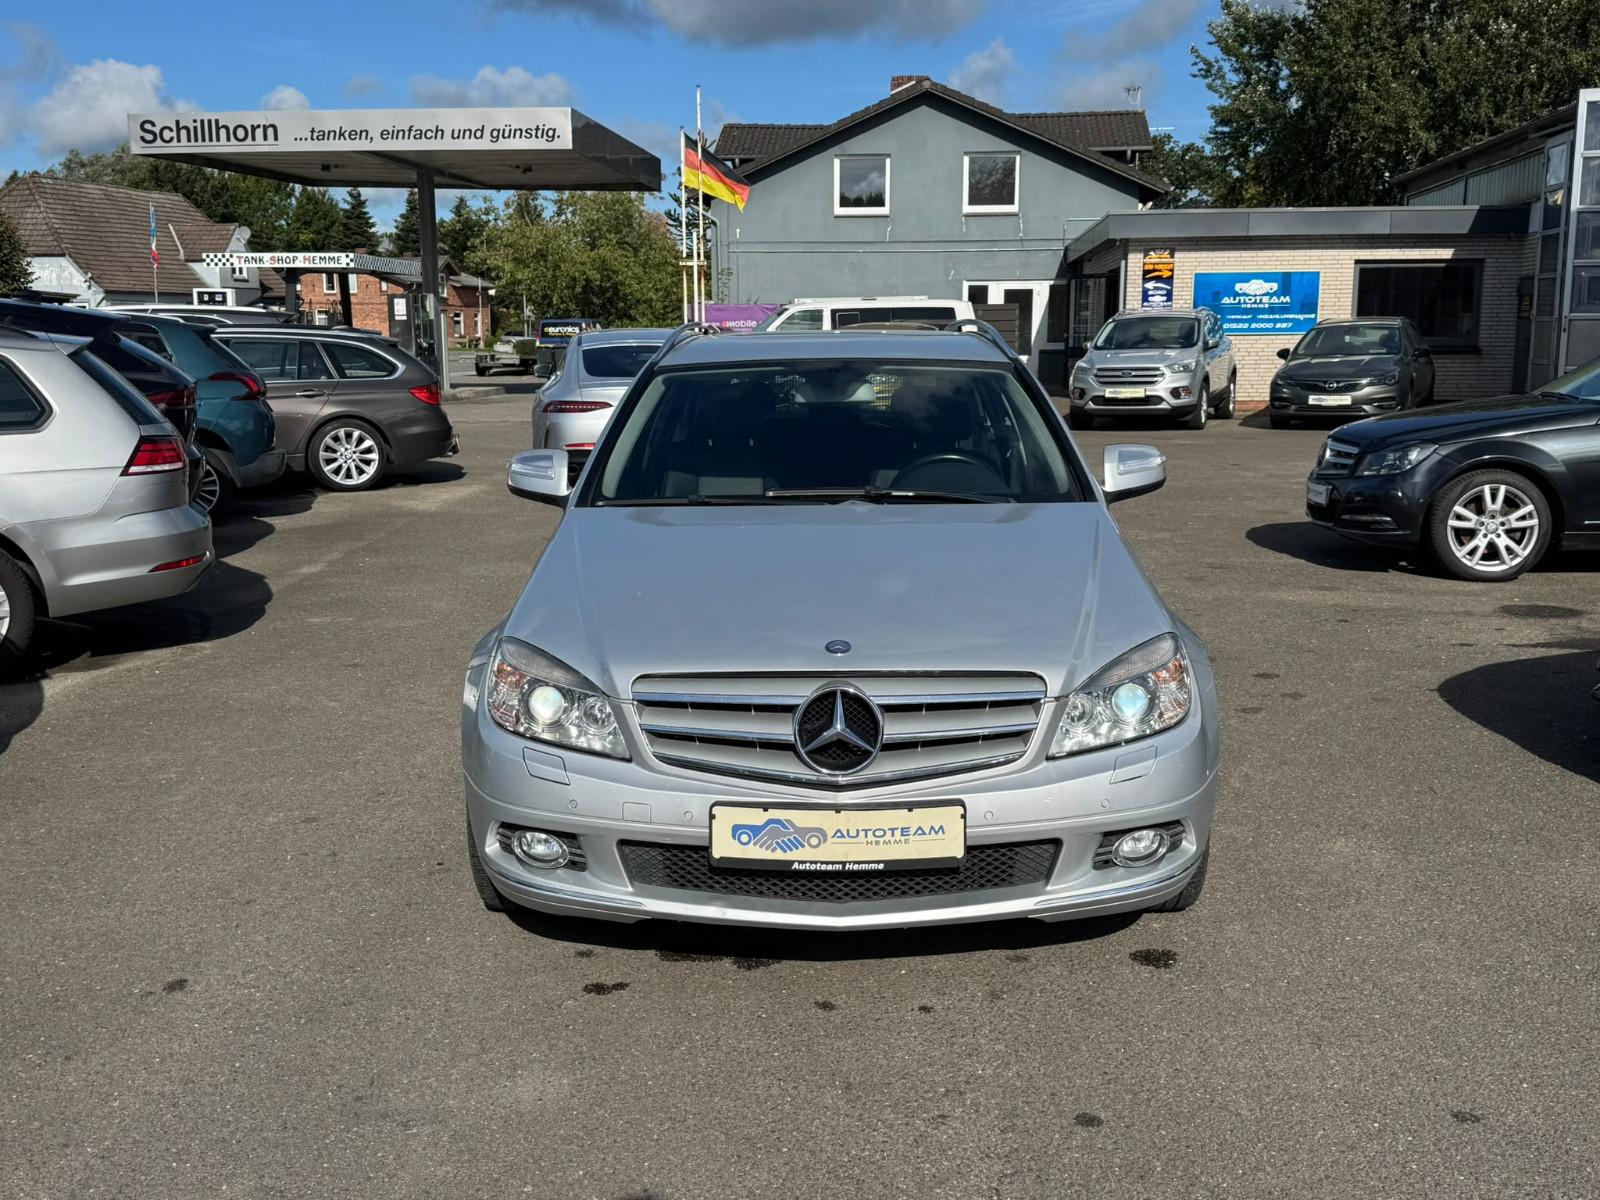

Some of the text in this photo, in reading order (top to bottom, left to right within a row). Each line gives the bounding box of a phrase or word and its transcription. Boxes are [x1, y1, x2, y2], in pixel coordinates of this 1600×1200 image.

[139, 118, 279, 144] Schillhorn
[293, 123, 561, 143] ...tanken, einfach und günstig.
[1220, 295, 1291, 304] AUTOTEAM
[831, 824, 946, 839] AUTOTEAM
[865, 838, 911, 846] HEMME
[791, 861, 885, 871] Autoteam Hemme
